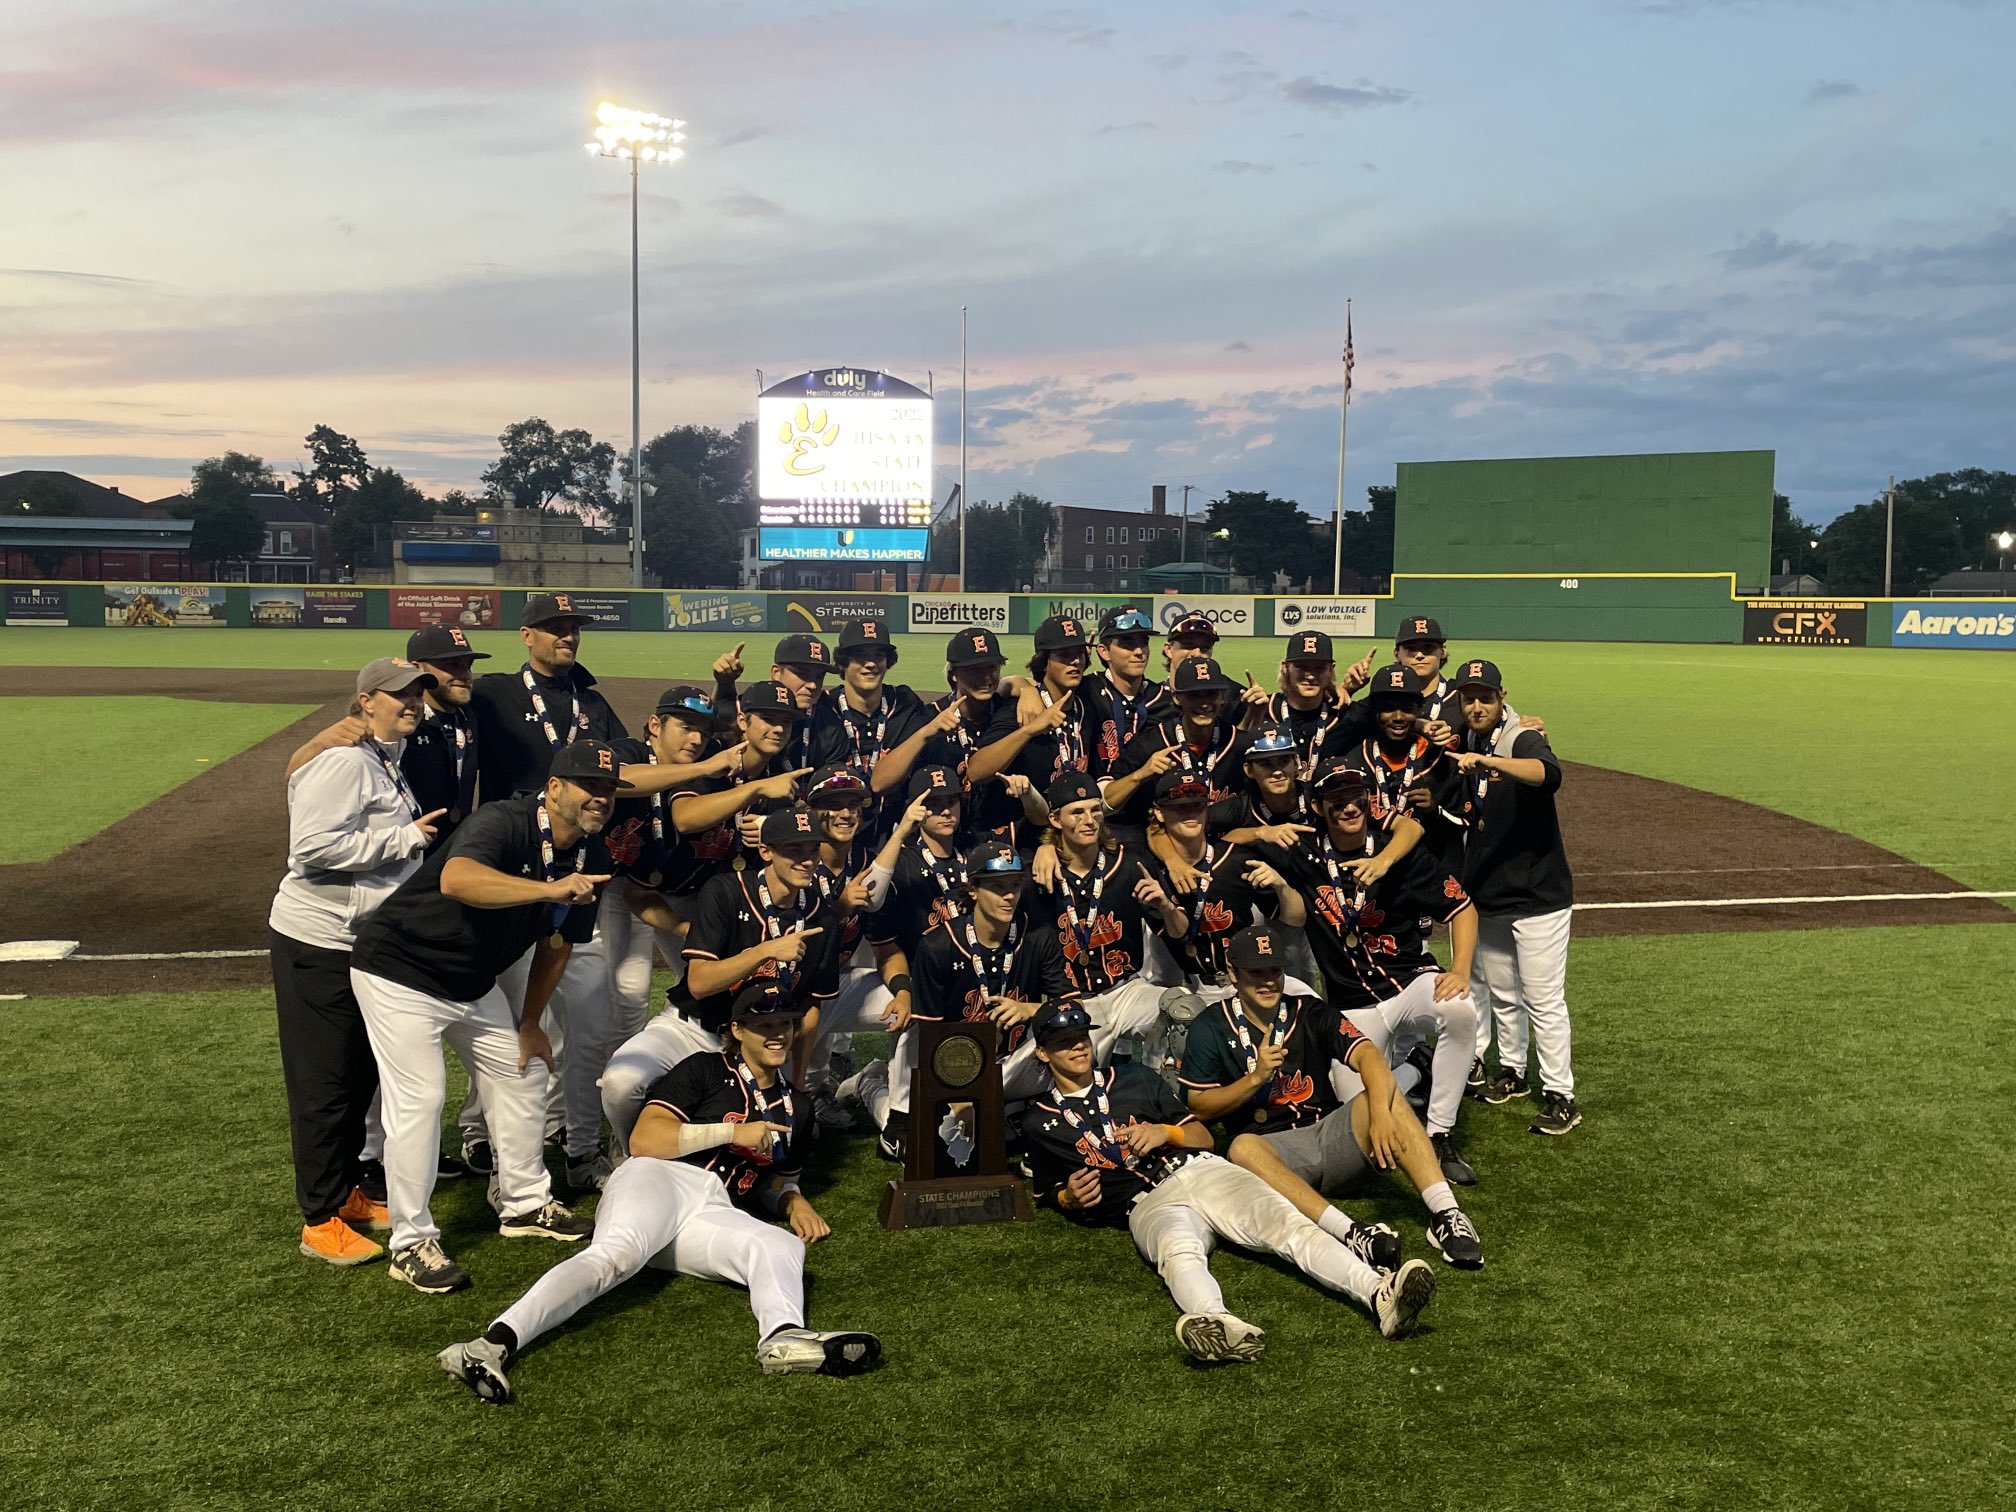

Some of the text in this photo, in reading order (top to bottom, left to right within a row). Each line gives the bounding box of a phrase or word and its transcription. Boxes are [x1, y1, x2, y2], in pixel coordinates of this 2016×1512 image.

[824, 370, 866, 390] duly
[765, 548, 924, 559] HEALTHIER MAKES HAPPIER.
[1560, 579, 1578, 588] 400
[12, 596, 59, 604] TRINITY
[555, 594, 572, 612] E
[668, 605, 729, 629] JOLIET
[912, 603, 1006, 623] Pipefitters
[1284, 611, 1300, 620] LVS
[1306, 605, 1367, 613] LOW VOLTAGE
[862, 622, 877, 639] E
[1061, 620, 1077, 636] E
[1415, 619, 1428, 634] E
[1772, 611, 1837, 635] CFX
[1896, 610, 2015, 636] Aaron's
[450, 626, 467, 647] E
[972, 635, 988, 652] E
[1304, 637, 1317, 653] E
[809, 642, 822, 661] E
[1195, 663, 1211, 680] E
[1469, 662, 1483, 677] E
[1390, 671, 1404, 687] E
[775, 686, 789, 705] E
[598, 749, 613, 771] E
[930, 770, 947, 787] E
[1256, 935, 1272, 955] E
[919, 1189, 1000, 1203] STATE CHAMPIONS
